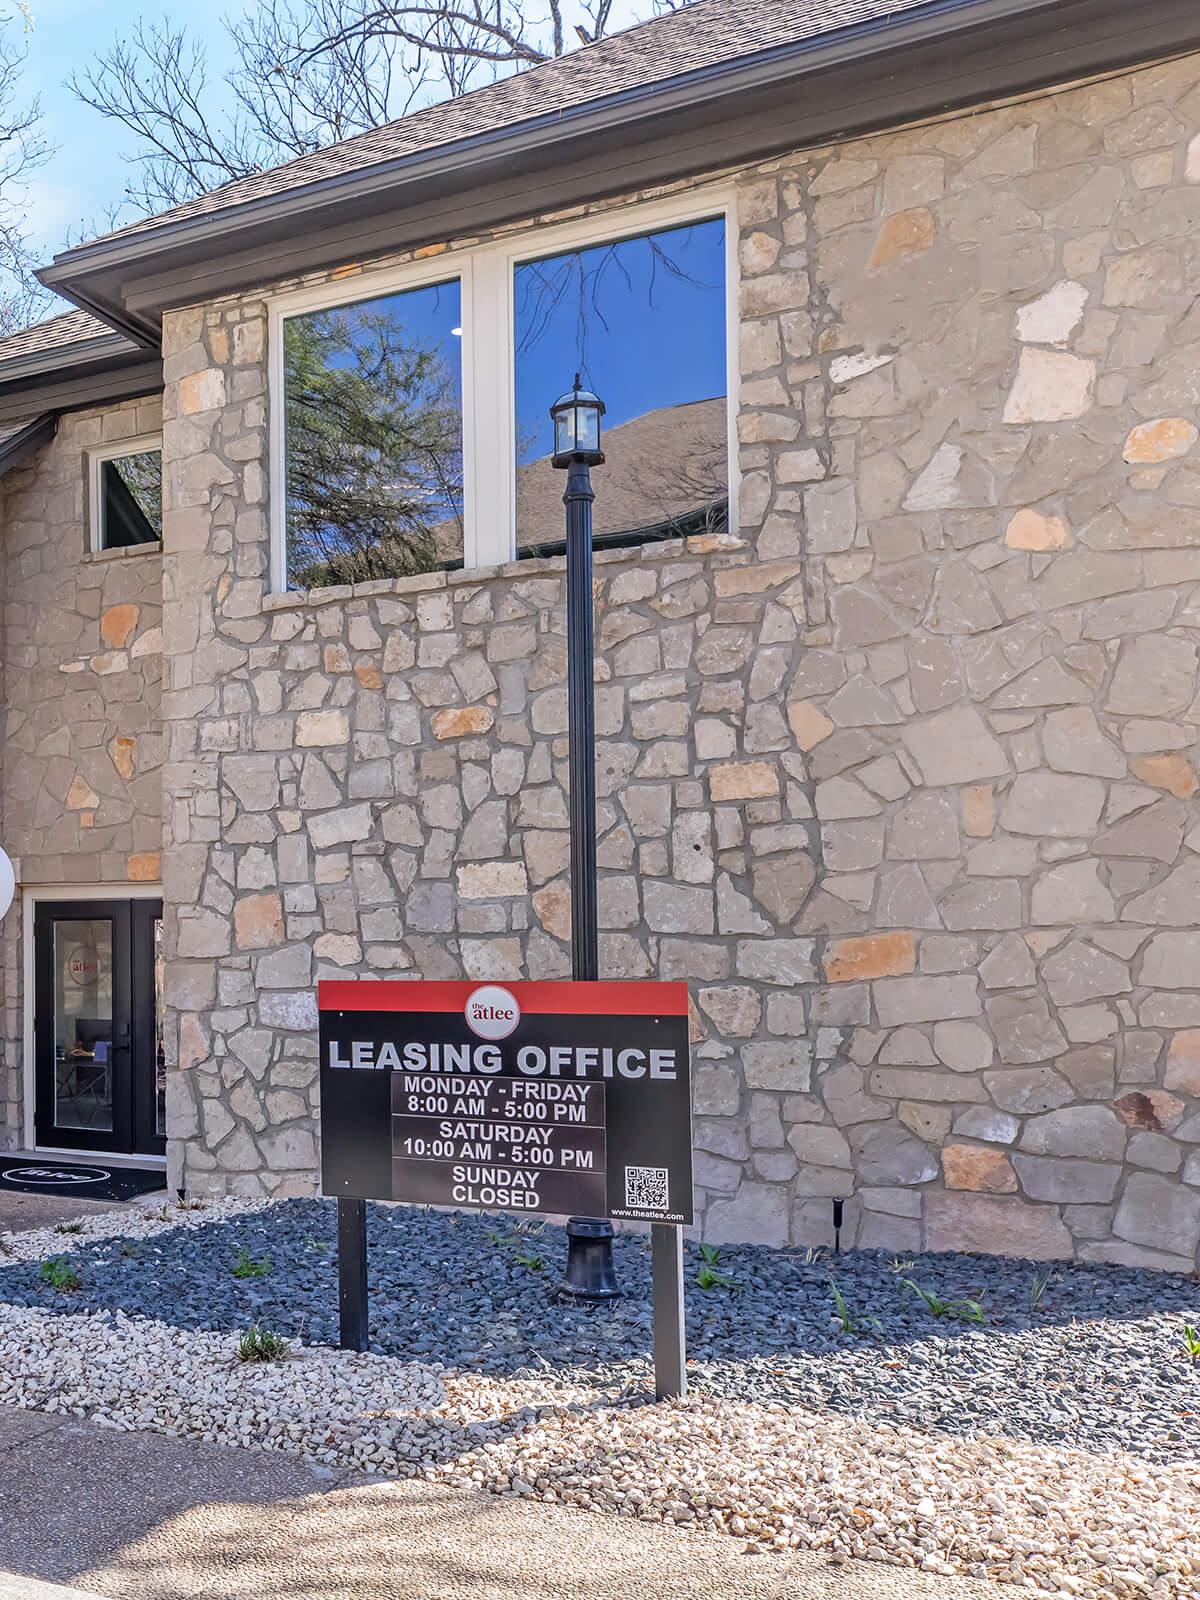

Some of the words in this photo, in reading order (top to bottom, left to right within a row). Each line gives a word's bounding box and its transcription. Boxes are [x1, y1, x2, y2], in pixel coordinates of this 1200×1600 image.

[472, 1002, 485, 1010] the
[473, 1006, 514, 1021] atlee
[329, 1041, 502, 1074] LEASING
[516, 1045, 677, 1080] OFFICE
[404, 1076, 493, 1097] MONDAY
[511, 1081, 591, 1102] FRIDAY
[407, 1095, 448, 1113] 8:00
[452, 1098, 485, 1116] AM
[504, 1101, 547, 1120] 5:00
[554, 1103, 586, 1122] PM
[439, 1121, 554, 1145] SATURDAY
[403, 1137, 455, 1157] 10:00
[459, 1142, 492, 1161] AM
[511, 1146, 554, 1165] 5:00
[560, 1149, 593, 1168] PM
[452, 1166, 540, 1189] SUNDAY
[452, 1186, 541, 1208] CLOSED
[611, 1209, 685, 1221] www.theatlee.com
